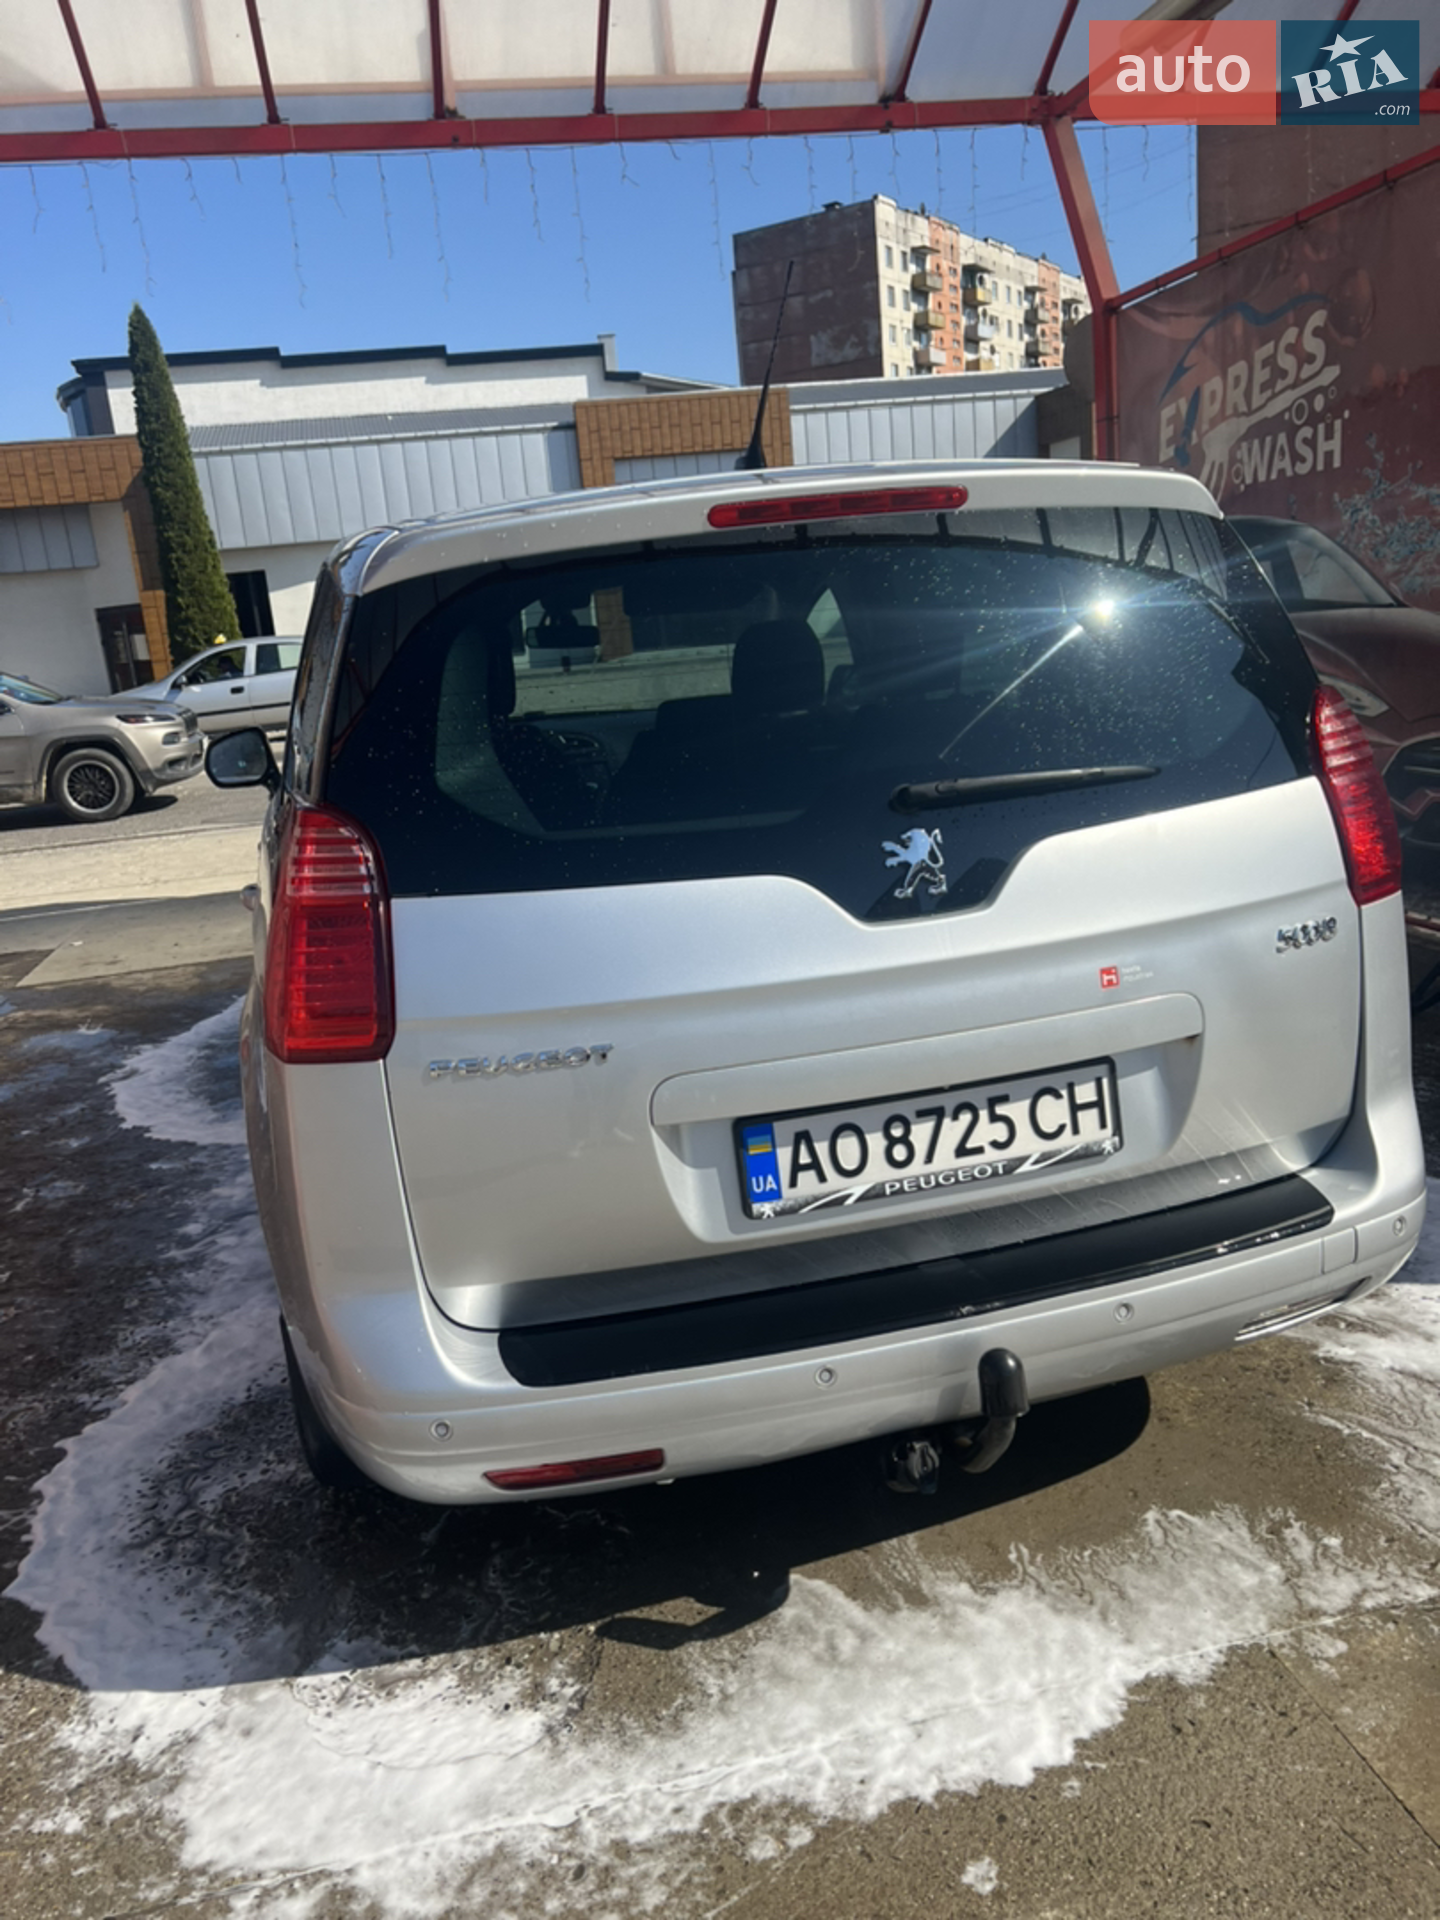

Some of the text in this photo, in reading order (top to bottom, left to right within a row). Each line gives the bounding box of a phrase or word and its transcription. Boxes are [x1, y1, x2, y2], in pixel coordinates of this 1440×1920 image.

[1240, 418, 1342, 485] WASH
[428, 1043, 615, 1079] PEUGEOT
[788, 1076, 1108, 1189] AO 8725 CH
[751, 1177, 778, 1194] UA
[884, 1161, 1008, 1196] PEUGEOT
